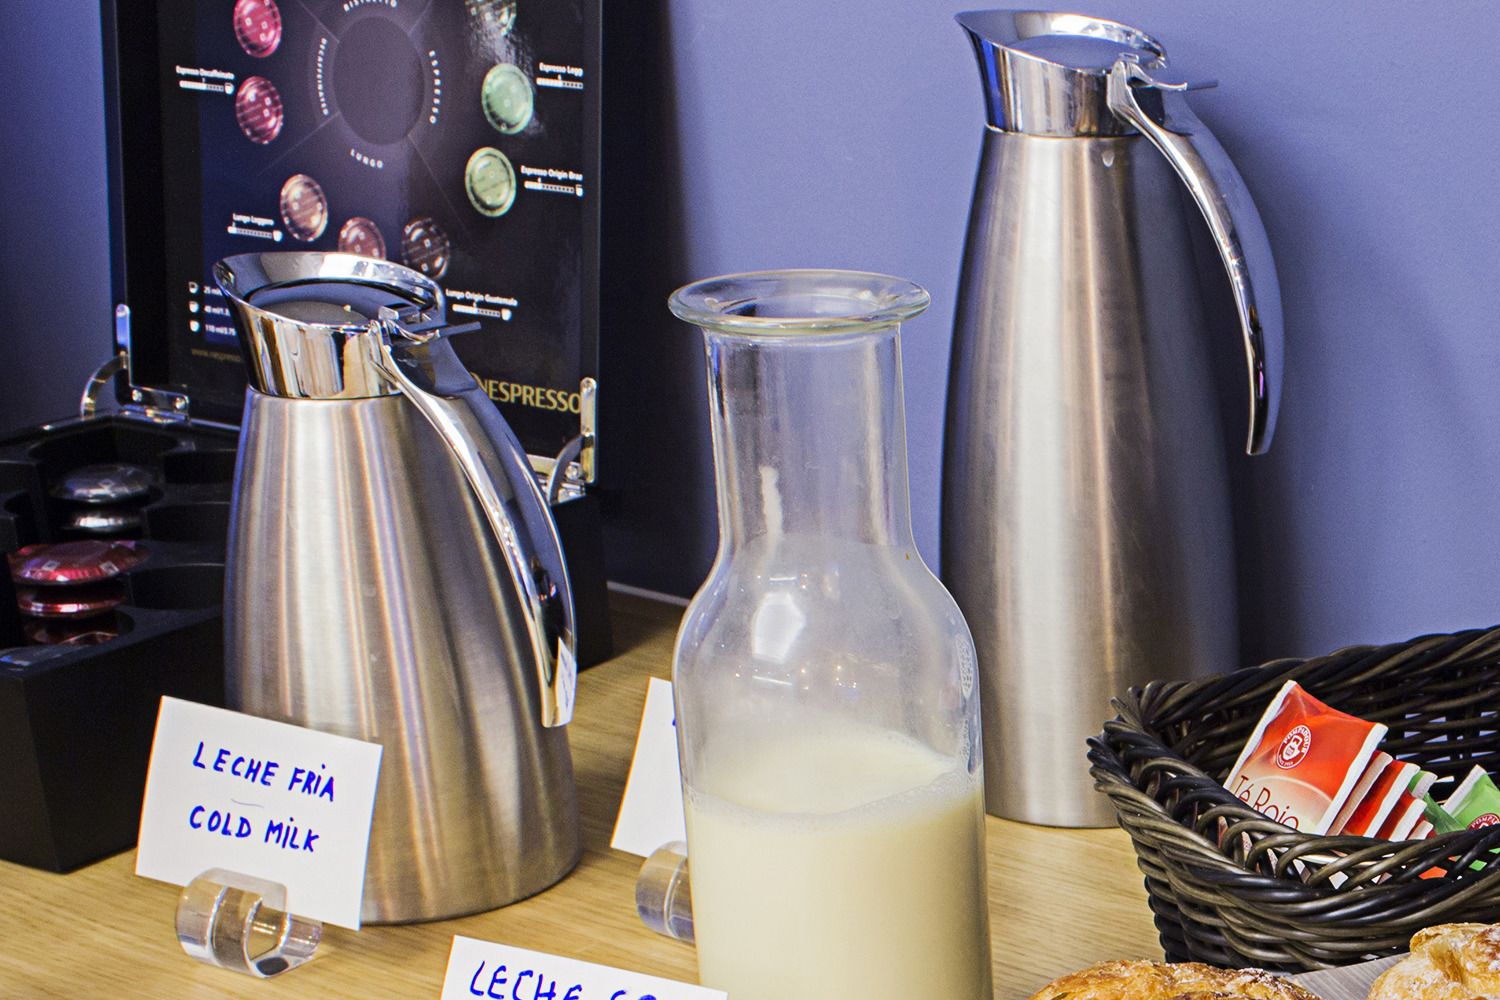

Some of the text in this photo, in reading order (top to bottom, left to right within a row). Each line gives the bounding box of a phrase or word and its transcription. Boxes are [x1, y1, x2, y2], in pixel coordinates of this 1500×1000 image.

[539, 62, 567, 75] Espresso
[428, 50, 442, 124] ESPRESSO
[350, 148, 384, 169] LUNGO
[520, 165, 547, 177] Espresso
[445, 288, 465, 300] Lungo
[191, 740, 280, 787] LECHE
[188, 804, 253, 839] COLD
